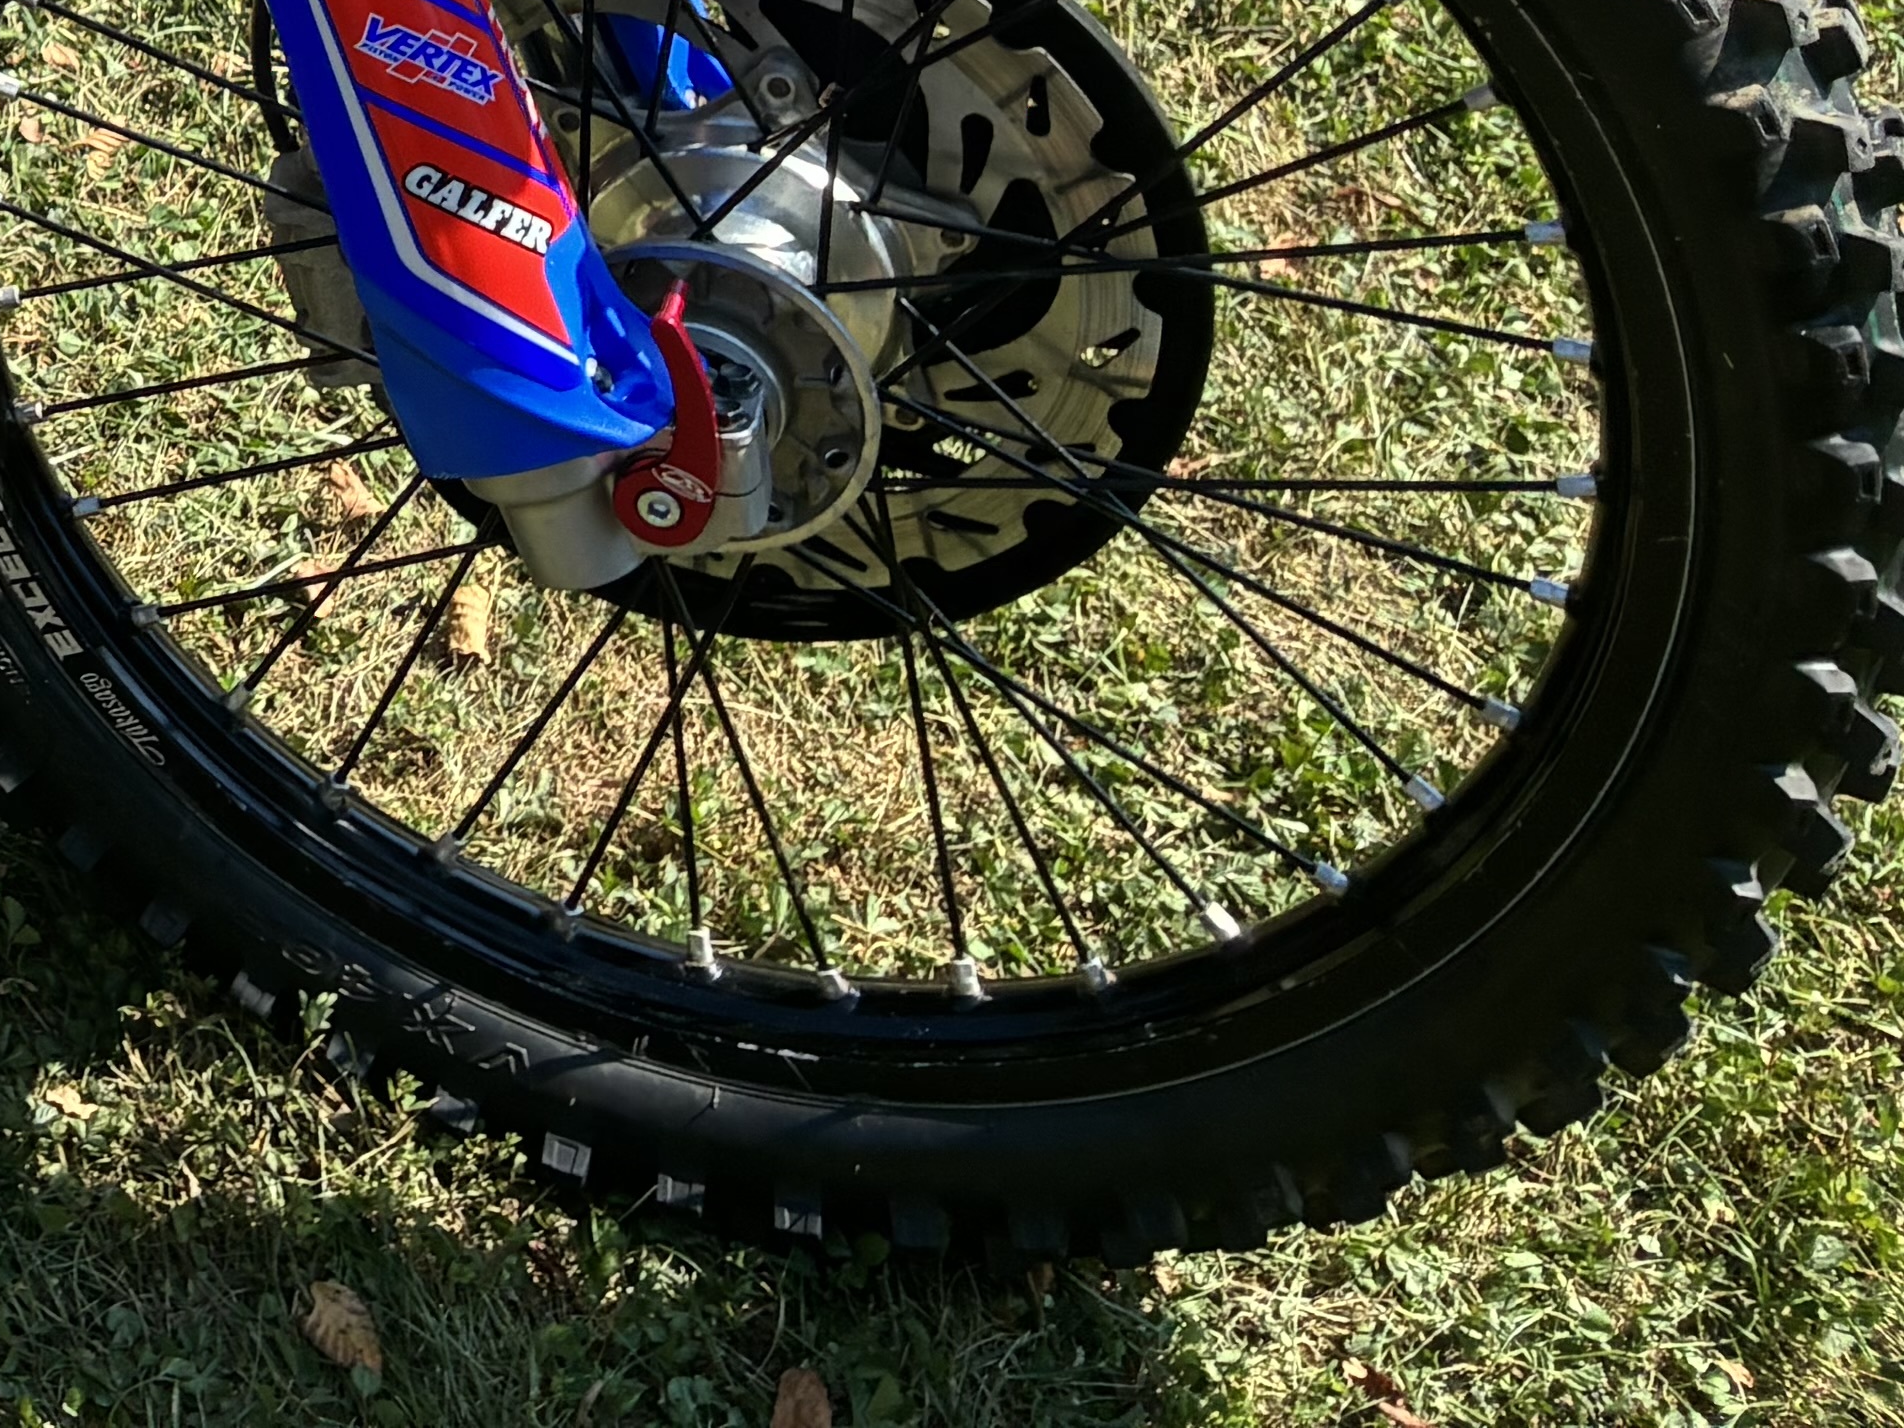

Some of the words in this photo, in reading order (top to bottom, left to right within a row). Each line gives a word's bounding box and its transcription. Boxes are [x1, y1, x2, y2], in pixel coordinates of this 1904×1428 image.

[362, 15, 504, 99] VERTEX
[404, 164, 553, 253] GALFER
[79, 672, 166, 768] Takasago
